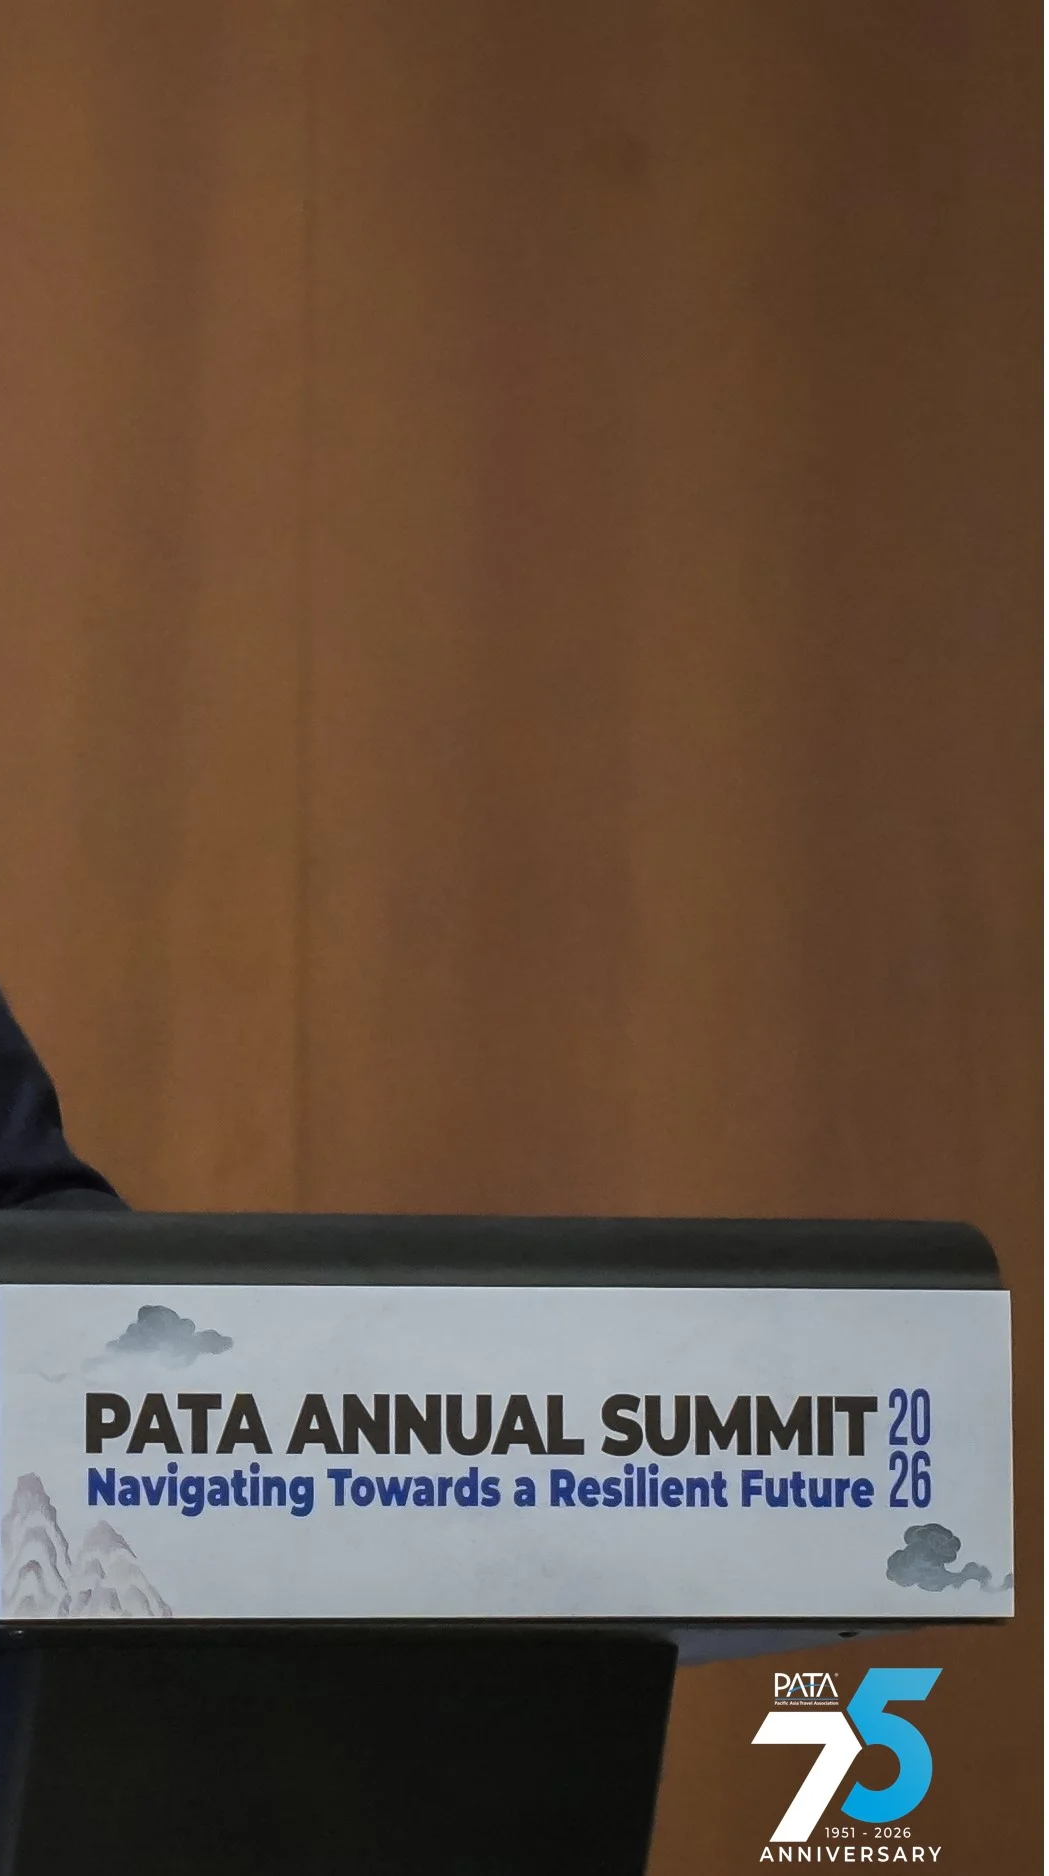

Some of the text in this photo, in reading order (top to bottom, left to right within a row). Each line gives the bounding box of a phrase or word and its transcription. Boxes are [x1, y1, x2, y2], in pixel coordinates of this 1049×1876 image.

[85, 1392, 878, 1457] PATA ANNUAL SUMMIT
[888, 1388, 931, 1446] 20
[87, 1462, 875, 1517] Navigating Towards a Resilient Future
[888, 1450, 932, 1508] 26
